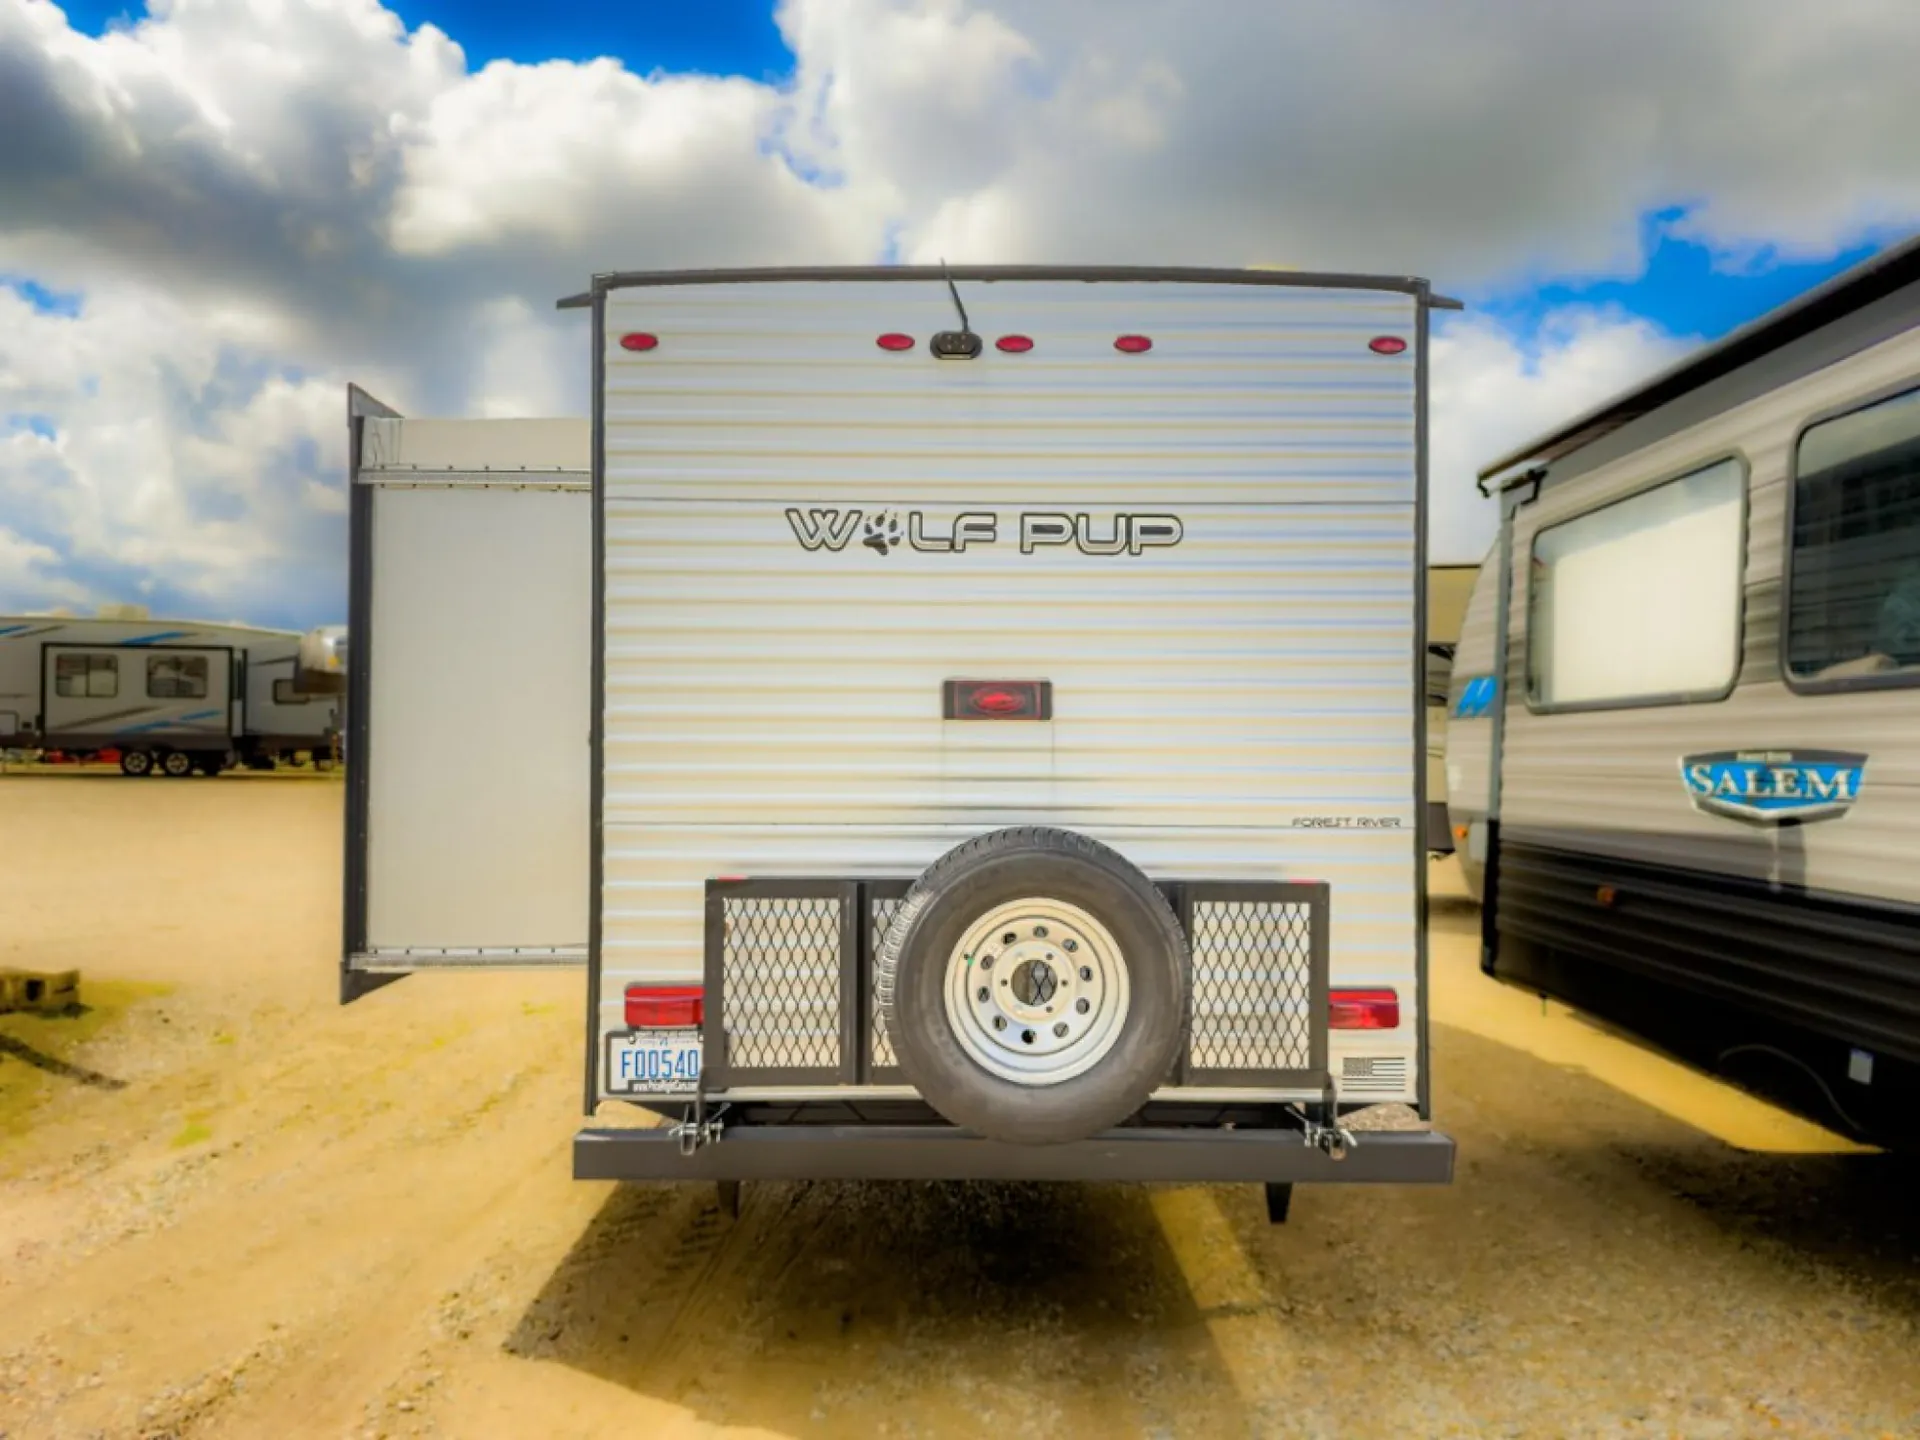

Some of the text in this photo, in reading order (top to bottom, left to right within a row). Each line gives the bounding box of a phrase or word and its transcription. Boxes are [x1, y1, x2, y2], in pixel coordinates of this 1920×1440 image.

[1020, 512, 1184, 555] PUP
[1691, 764, 1852, 800] SALEM
[1292, 816, 1401, 828] FOREST RIVER
